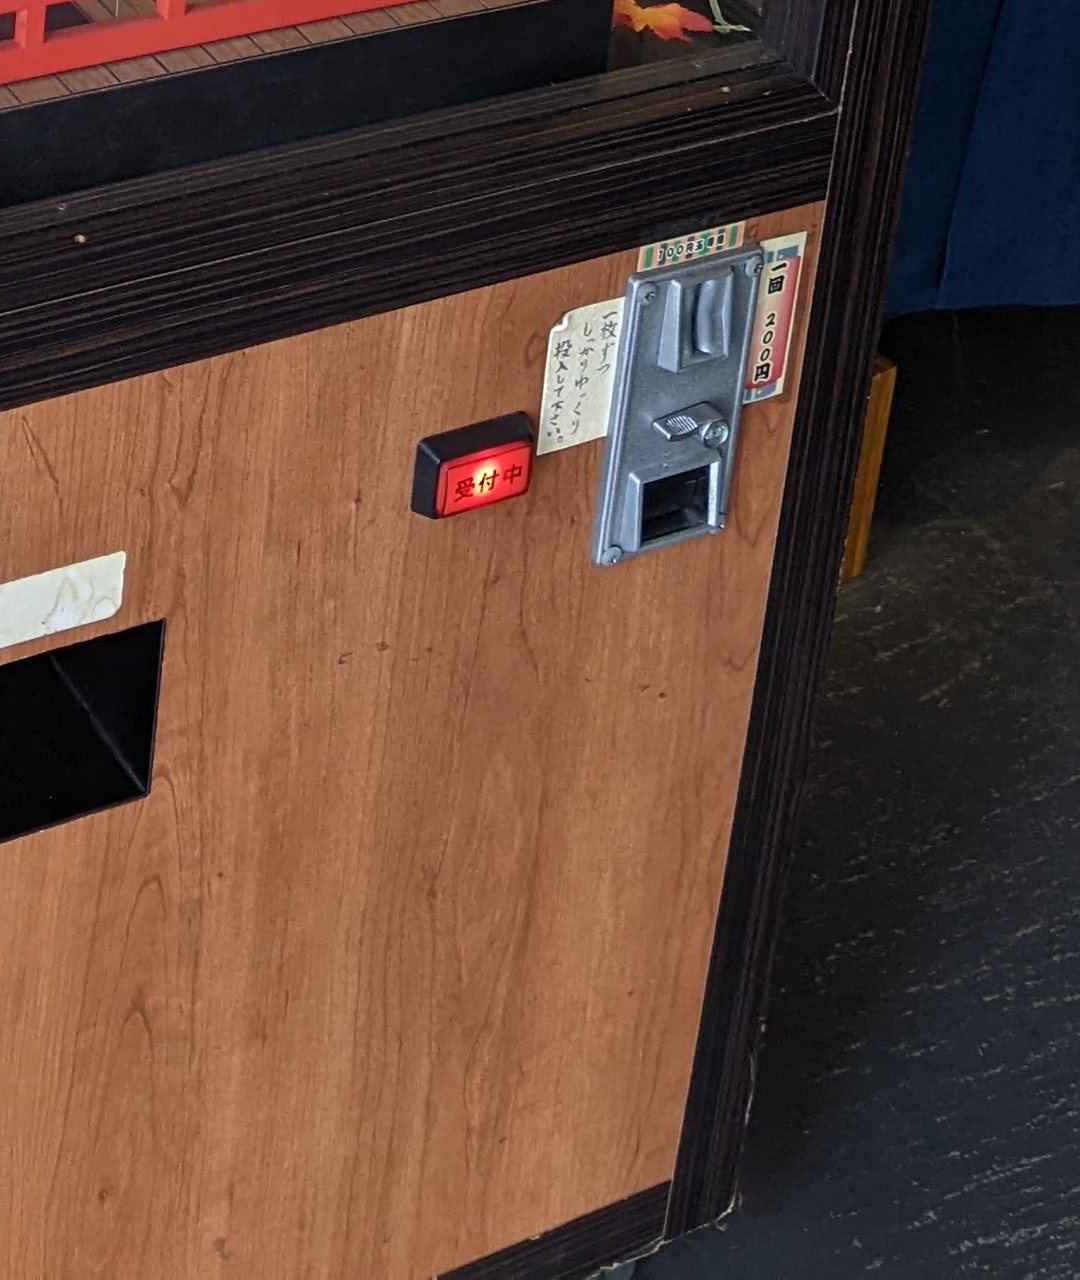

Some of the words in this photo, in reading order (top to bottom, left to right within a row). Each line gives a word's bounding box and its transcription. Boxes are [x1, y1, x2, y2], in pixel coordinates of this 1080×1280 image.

[767, 262, 788, 295] 一回
[597, 311, 619, 375] 一枚ずつ
[754, 312, 776, 382] 200円
[570, 321, 595, 436] しっかりゆっくり
[453, 464, 523, 502] 受付中
